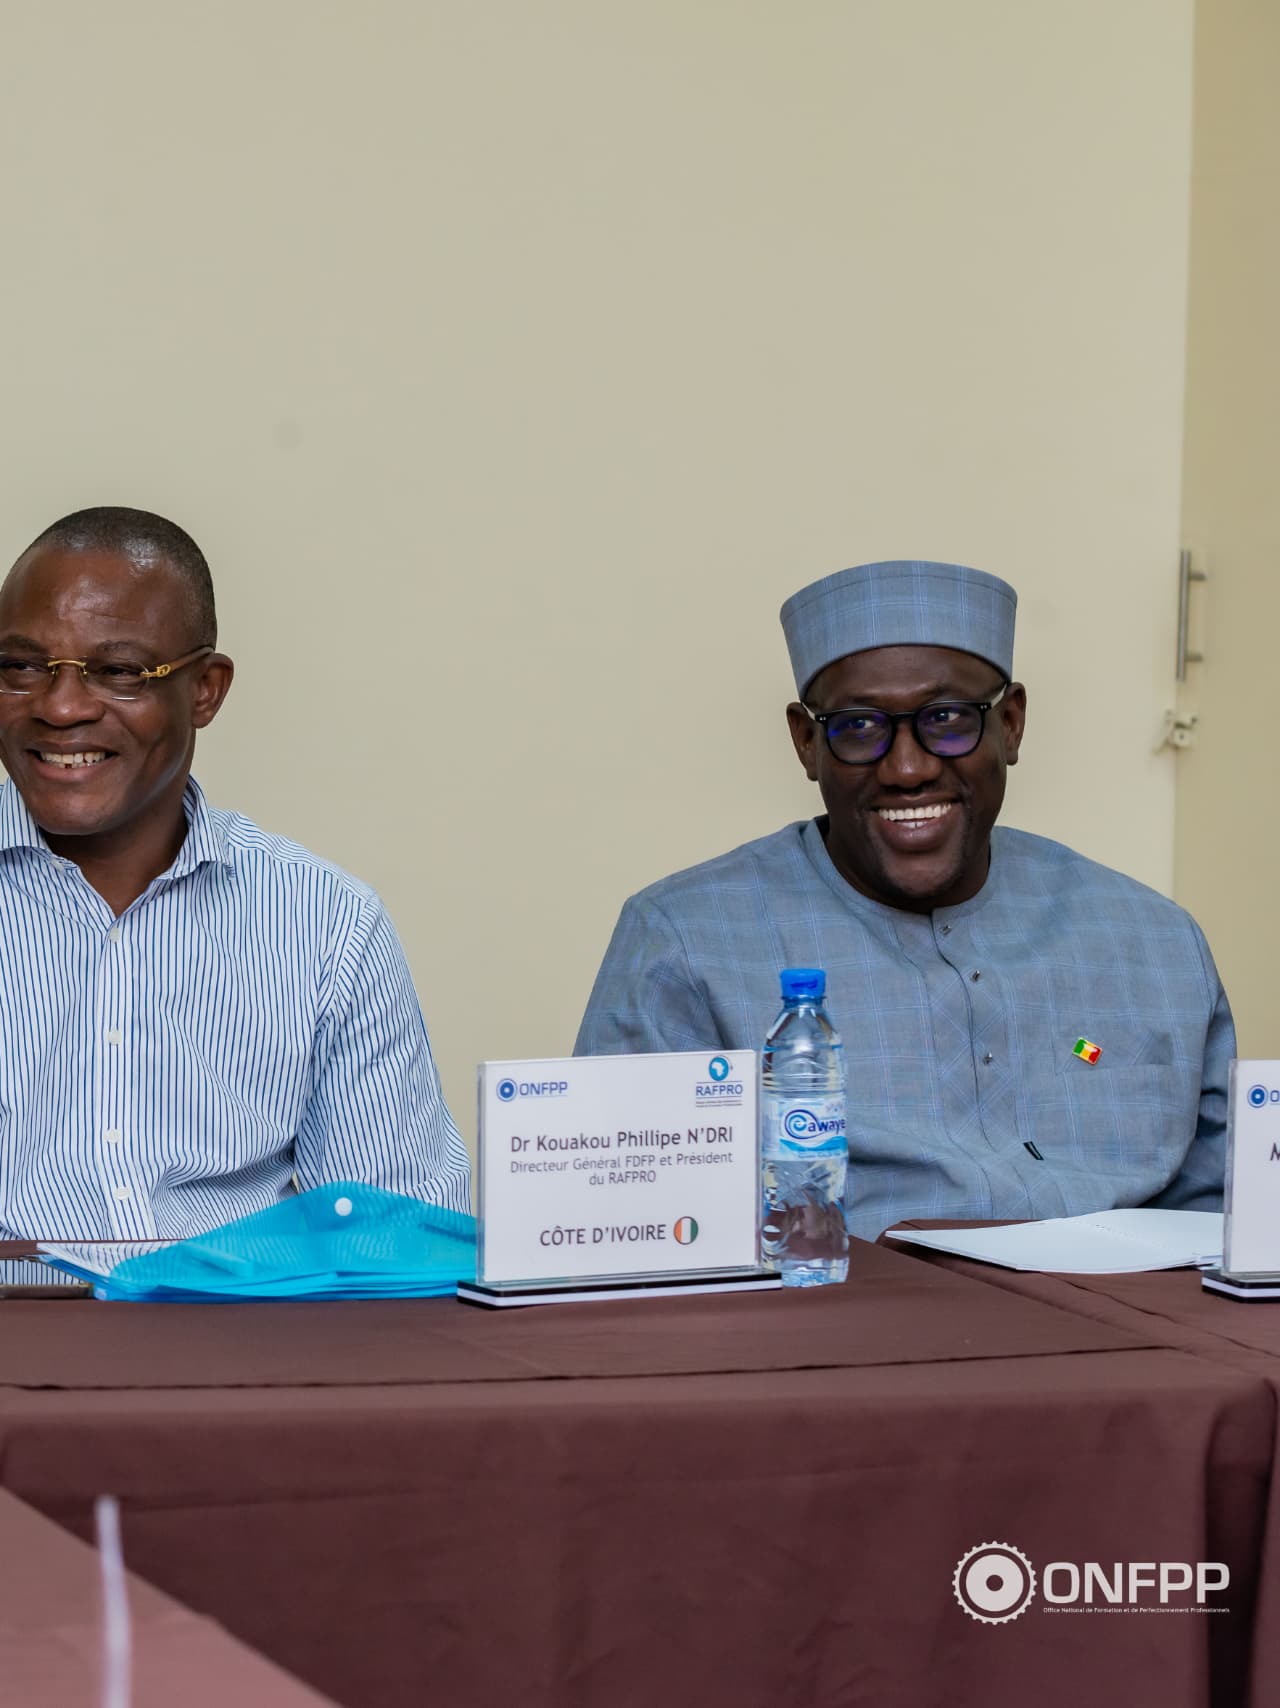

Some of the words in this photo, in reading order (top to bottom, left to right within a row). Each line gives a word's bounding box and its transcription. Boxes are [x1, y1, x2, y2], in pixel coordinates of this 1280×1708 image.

[519, 1081, 568, 1096] ONFPP
[695, 1084, 743, 1096] RAFPRO
[511, 1136, 530, 1152] Dr
[537, 1133, 611, 1152] Kouakou
[617, 1129, 681, 1150] Phillipe
[510, 1159, 569, 1173] Directeur
[573, 1155, 621, 1170] Général
[625, 1154, 656, 1168] FDFP
[659, 1154, 673, 1166] et
[676, 1151, 734, 1165] Président
[589, 1173, 605, 1186] du
[608, 1170, 657, 1184] RAFPRO
[539, 1225, 586, 1246] CÔTE
[592, 1224, 667, 1244] D'IVOIRE
